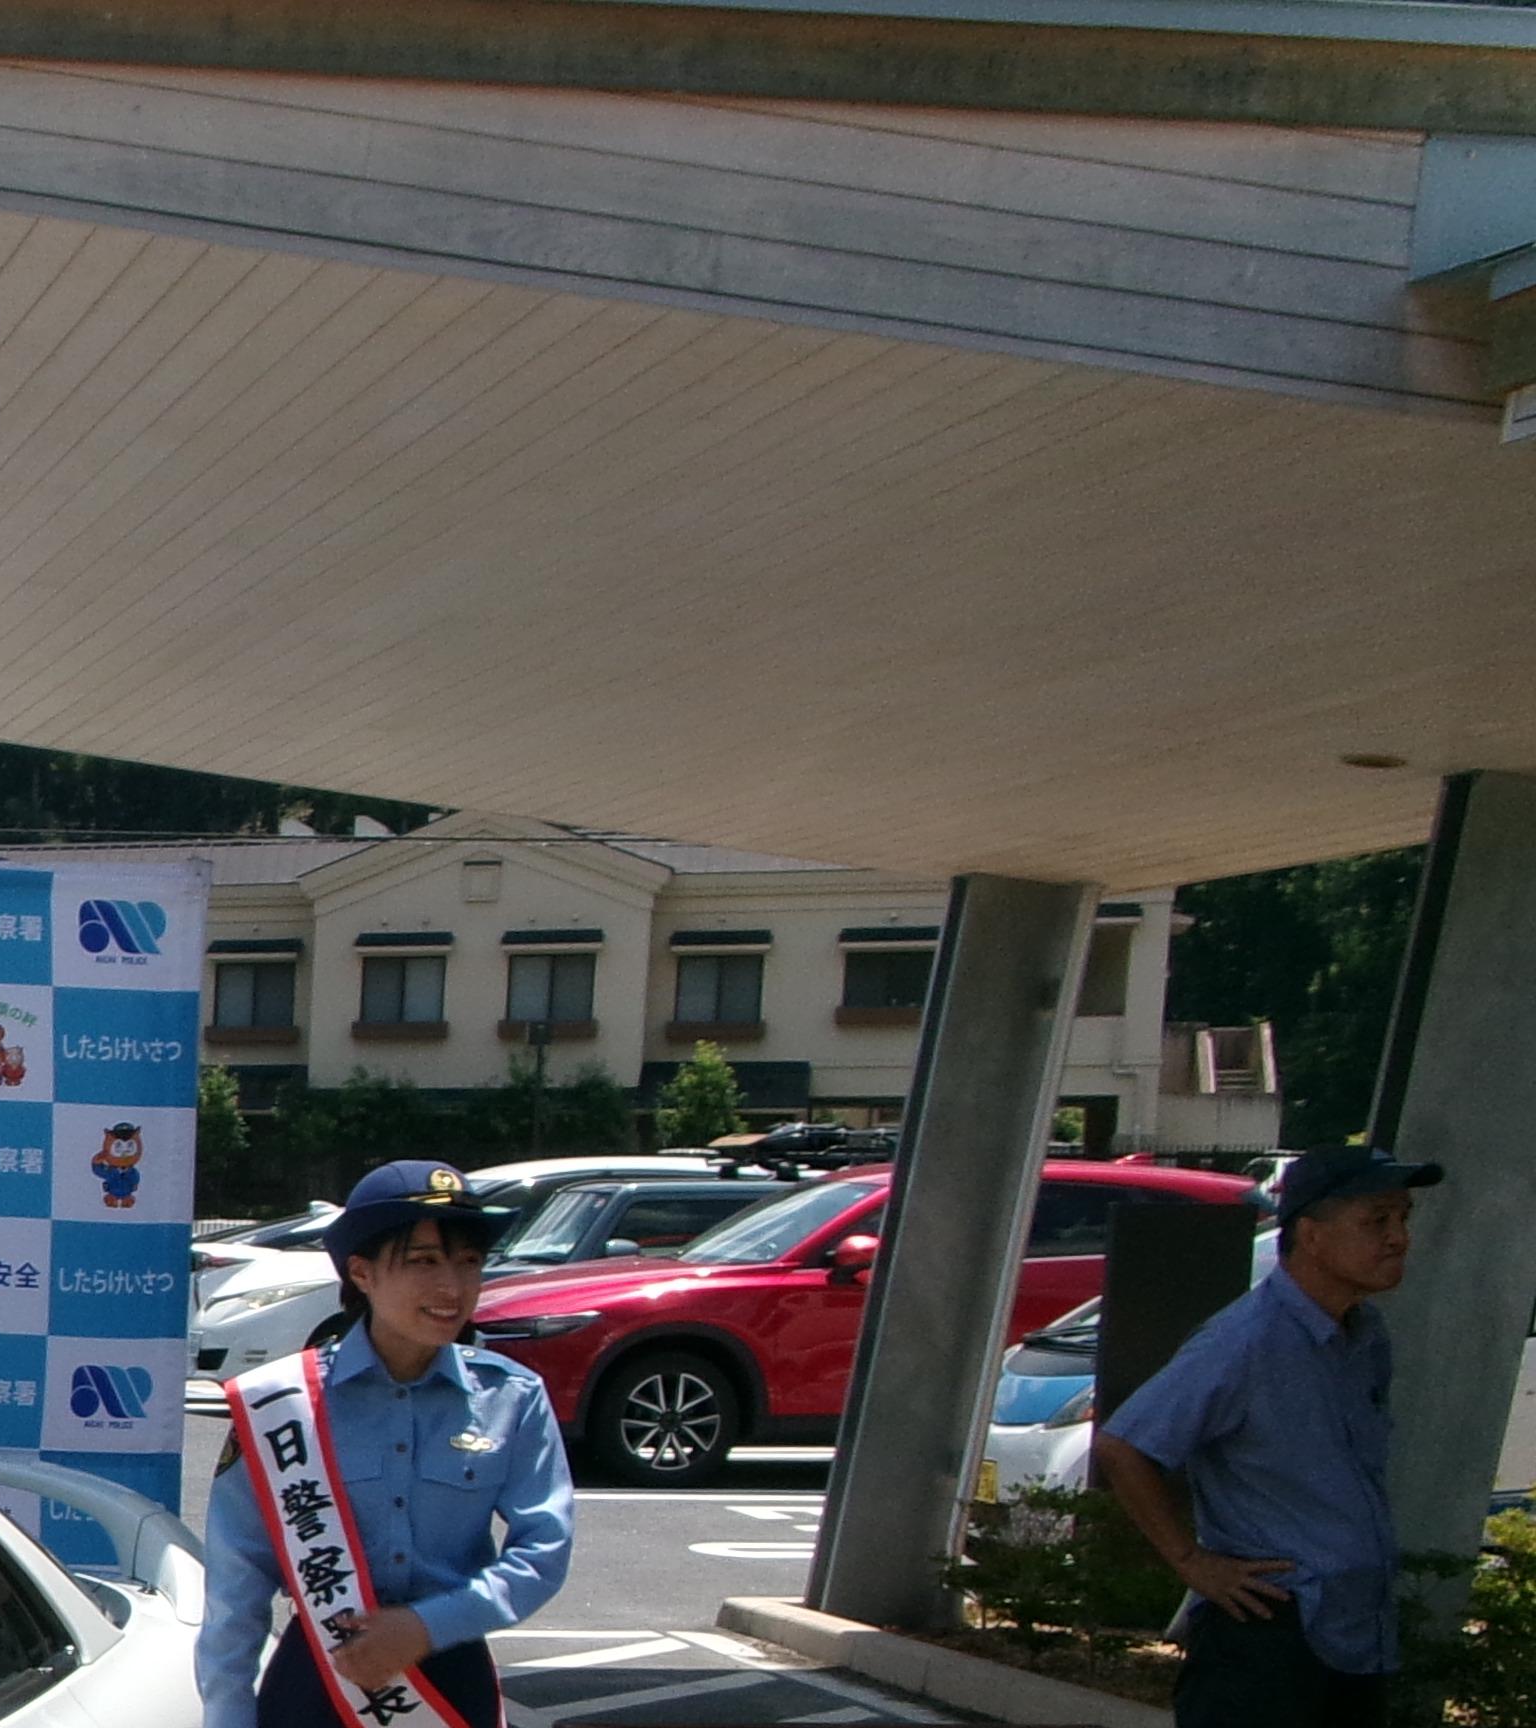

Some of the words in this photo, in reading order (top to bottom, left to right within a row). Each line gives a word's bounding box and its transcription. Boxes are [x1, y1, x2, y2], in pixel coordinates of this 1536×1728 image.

[62, 1034, 182, 1063] したらけいさつ
[58, 1267, 174, 1295] したらけいさつ
